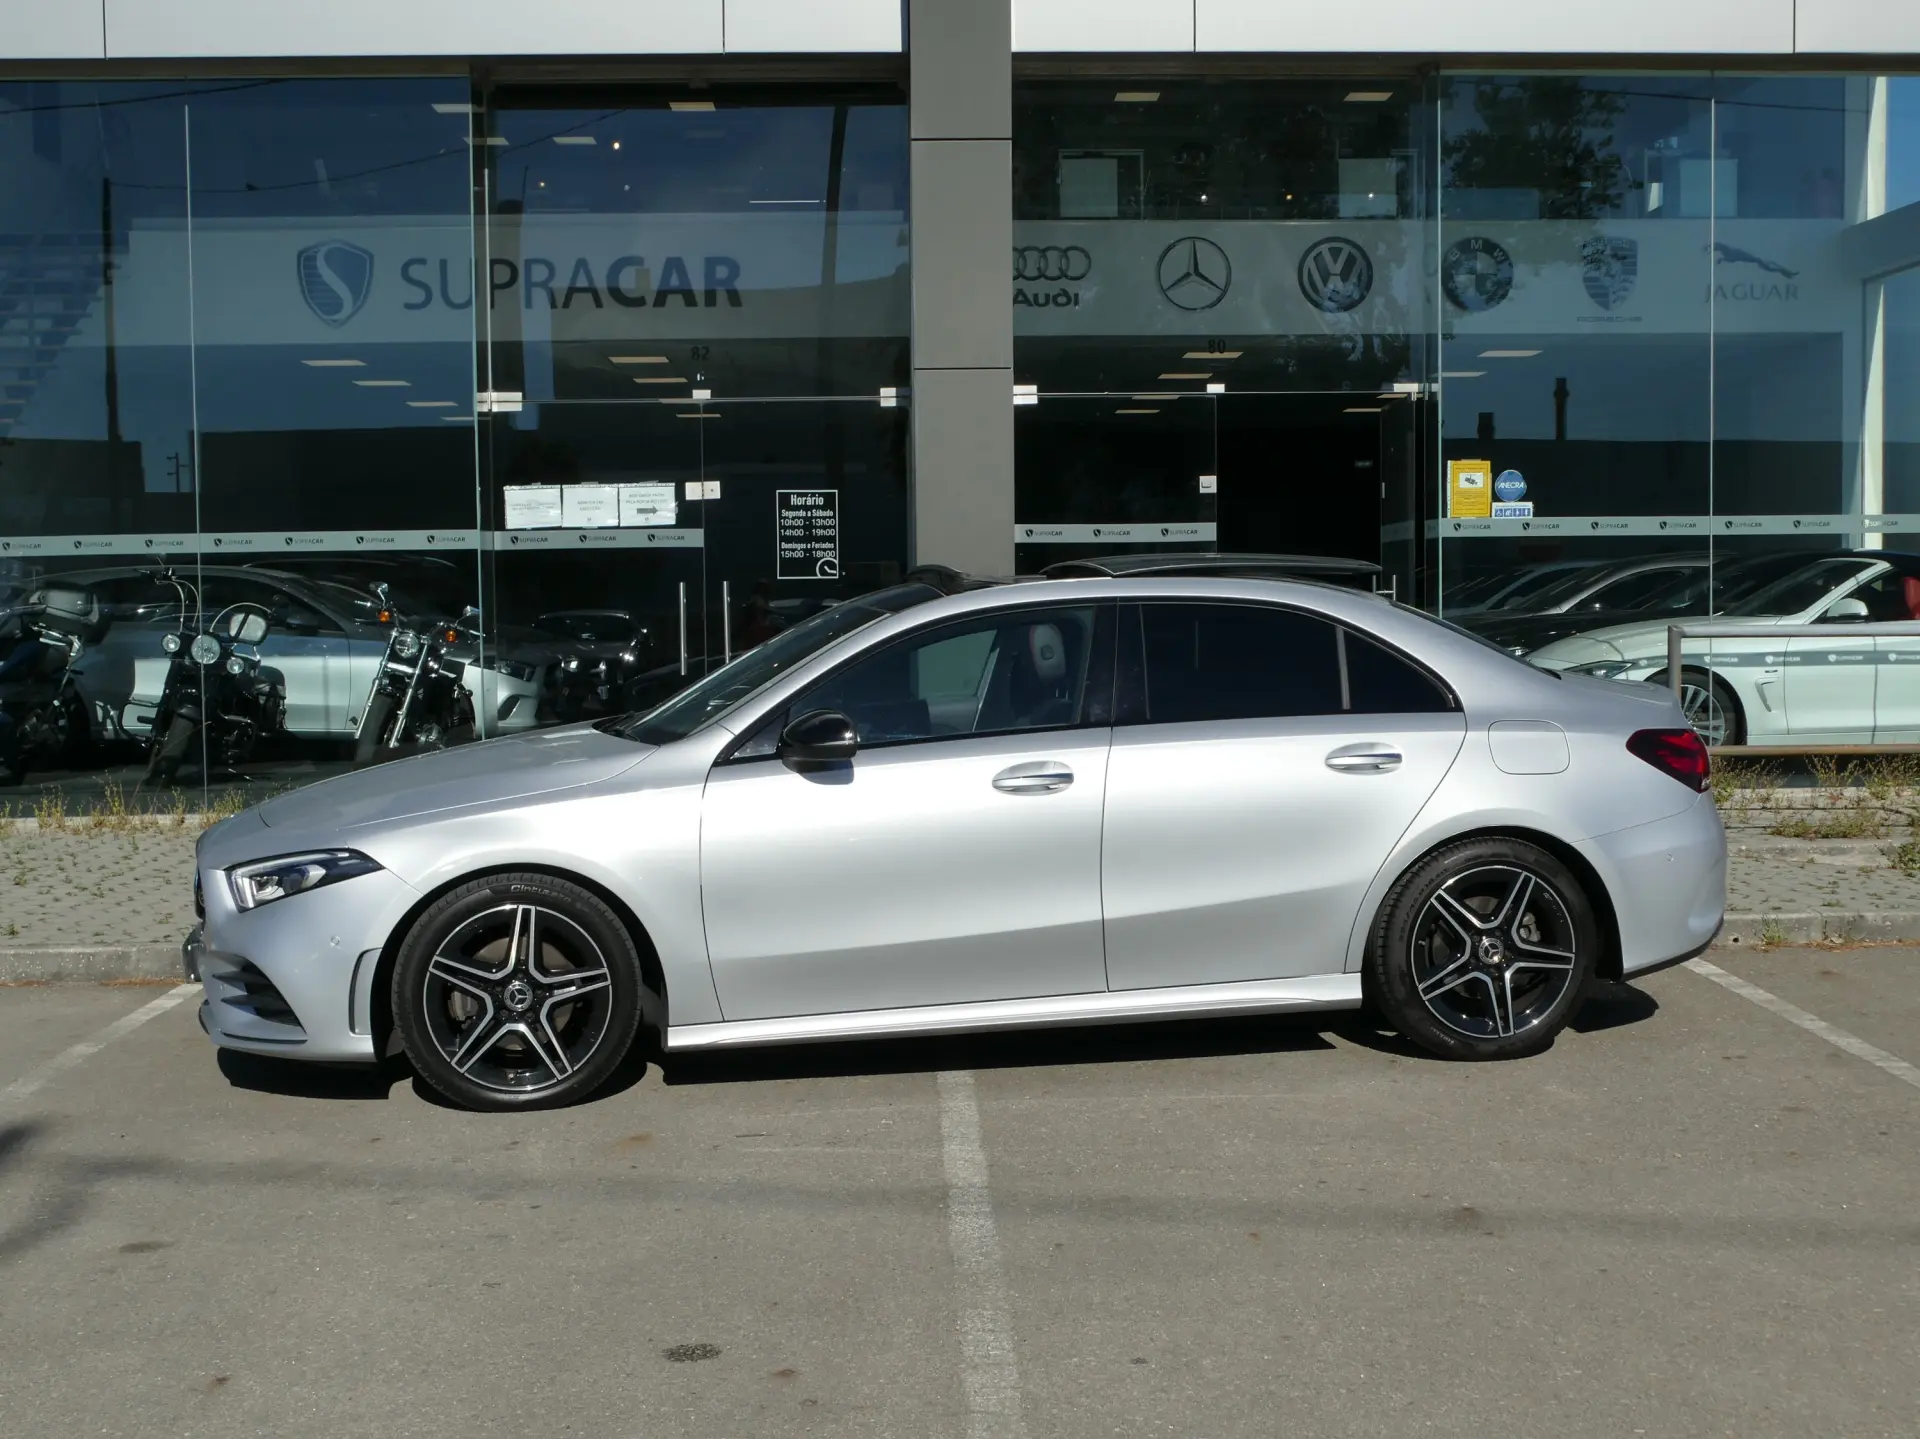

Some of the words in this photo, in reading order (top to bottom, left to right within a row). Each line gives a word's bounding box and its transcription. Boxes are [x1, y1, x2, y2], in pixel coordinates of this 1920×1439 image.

[401, 255, 743, 310] SUPRACAR
[1013, 288, 1080, 307] Audi
[1704, 283, 1798, 303] JAGUAR
[691, 346, 710, 361] 82
[1208, 339, 1226, 354] 80
[1498, 481, 1525, 489] ANECRA
[790, 494, 824, 506] Horário
[781, 509, 806, 518] Segunda
[812, 509, 834, 517] Sábado
[781, 542, 806, 550] Domingos
